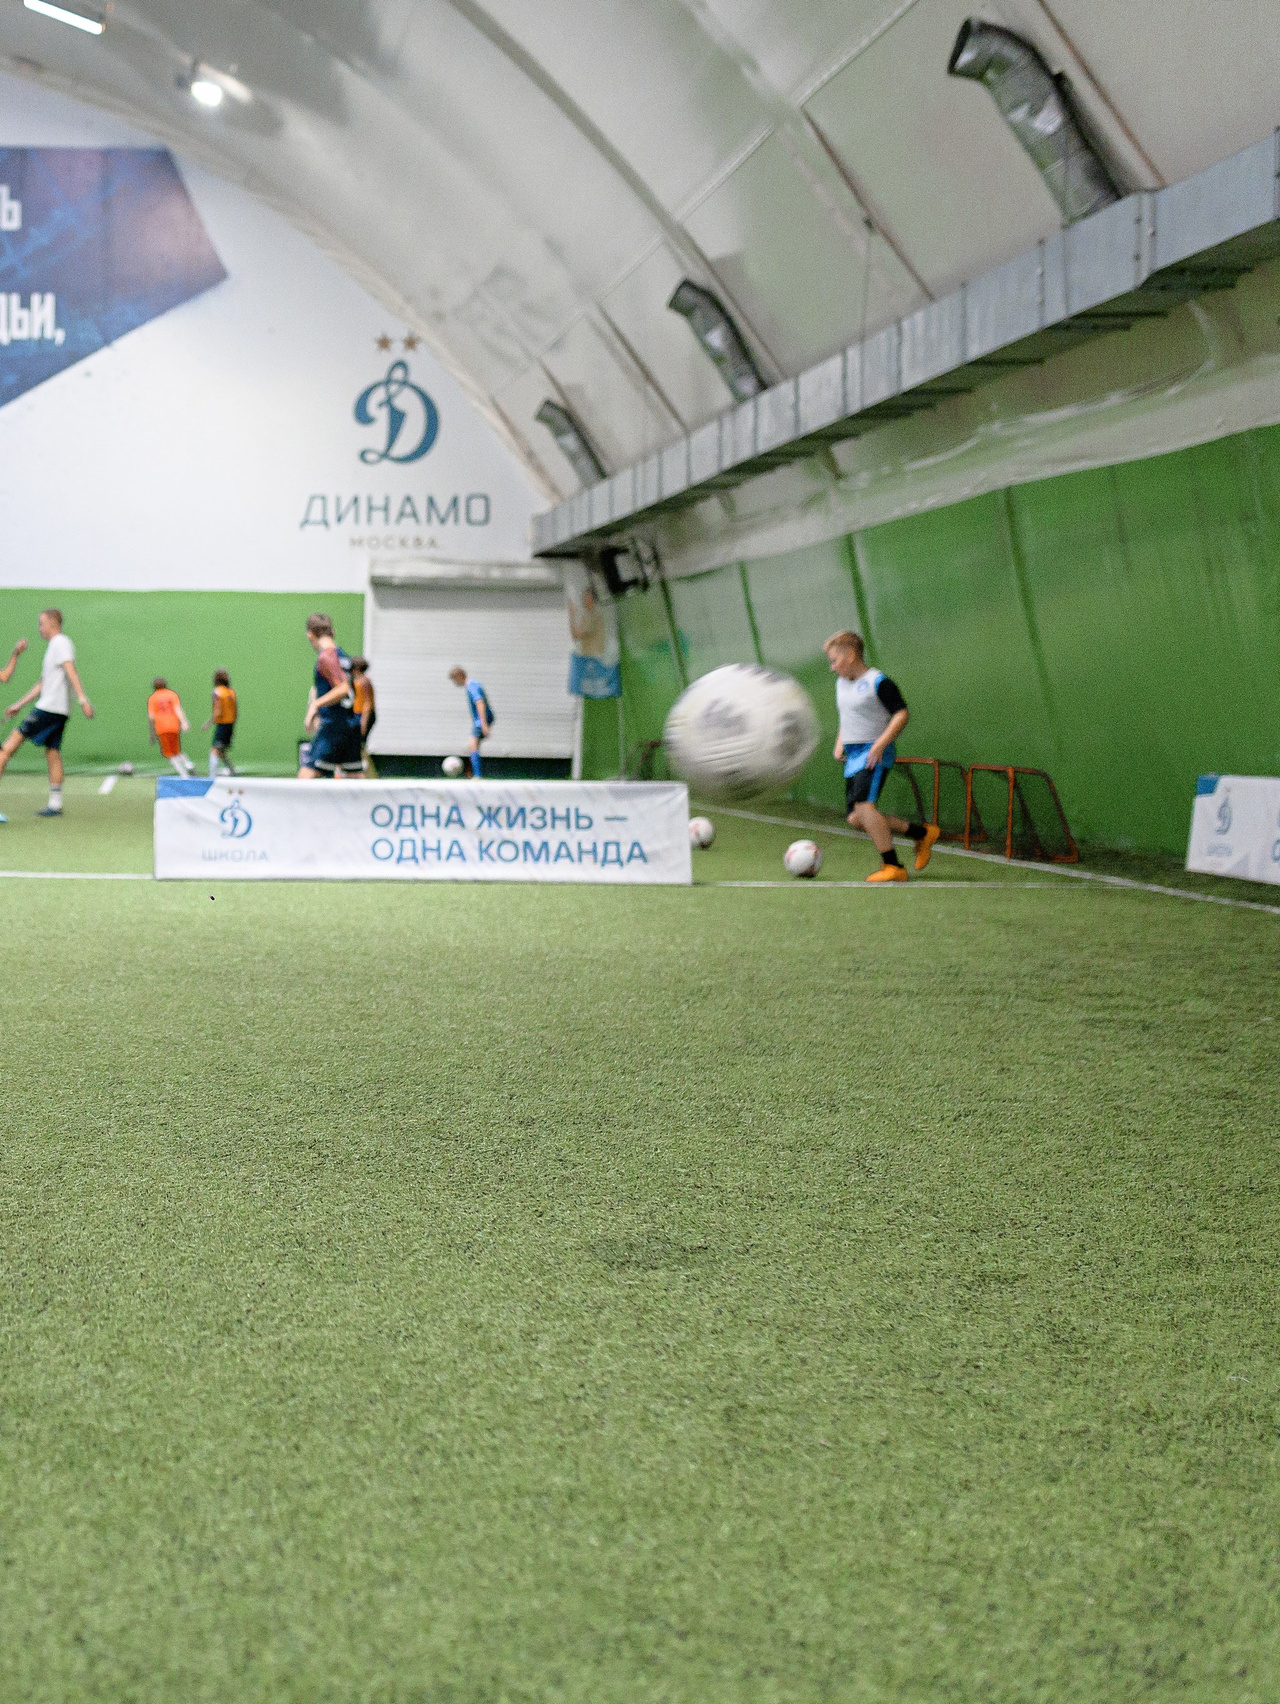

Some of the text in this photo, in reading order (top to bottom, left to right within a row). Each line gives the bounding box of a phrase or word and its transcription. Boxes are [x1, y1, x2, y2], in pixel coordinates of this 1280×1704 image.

[300, 492, 491, 531] ДИНАМО
[349, 535, 438, 550] МОСКВА
[371, 805, 465, 831] ОДНА
[476, 805, 593, 831] ЖИЗНЬ
[201, 849, 268, 863] ШКОЛА
[371, 838, 648, 868] ОДНА КОМАНДА
